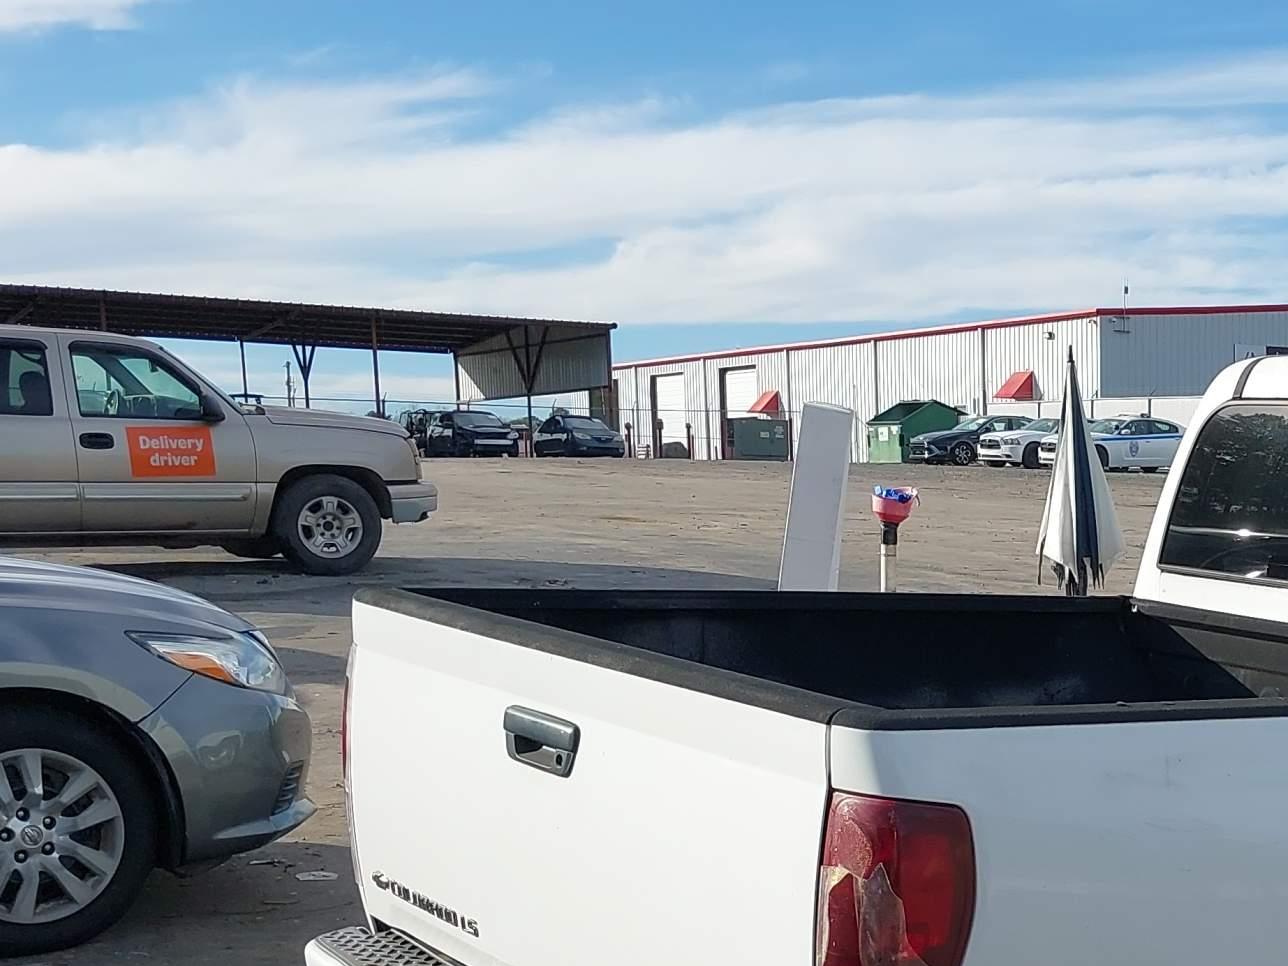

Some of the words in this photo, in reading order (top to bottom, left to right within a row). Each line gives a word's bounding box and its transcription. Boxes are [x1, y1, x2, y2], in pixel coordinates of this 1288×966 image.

[139, 435, 204, 452] Delivery
[150, 453, 198, 467] driver
[460, 915, 479, 938] LS
